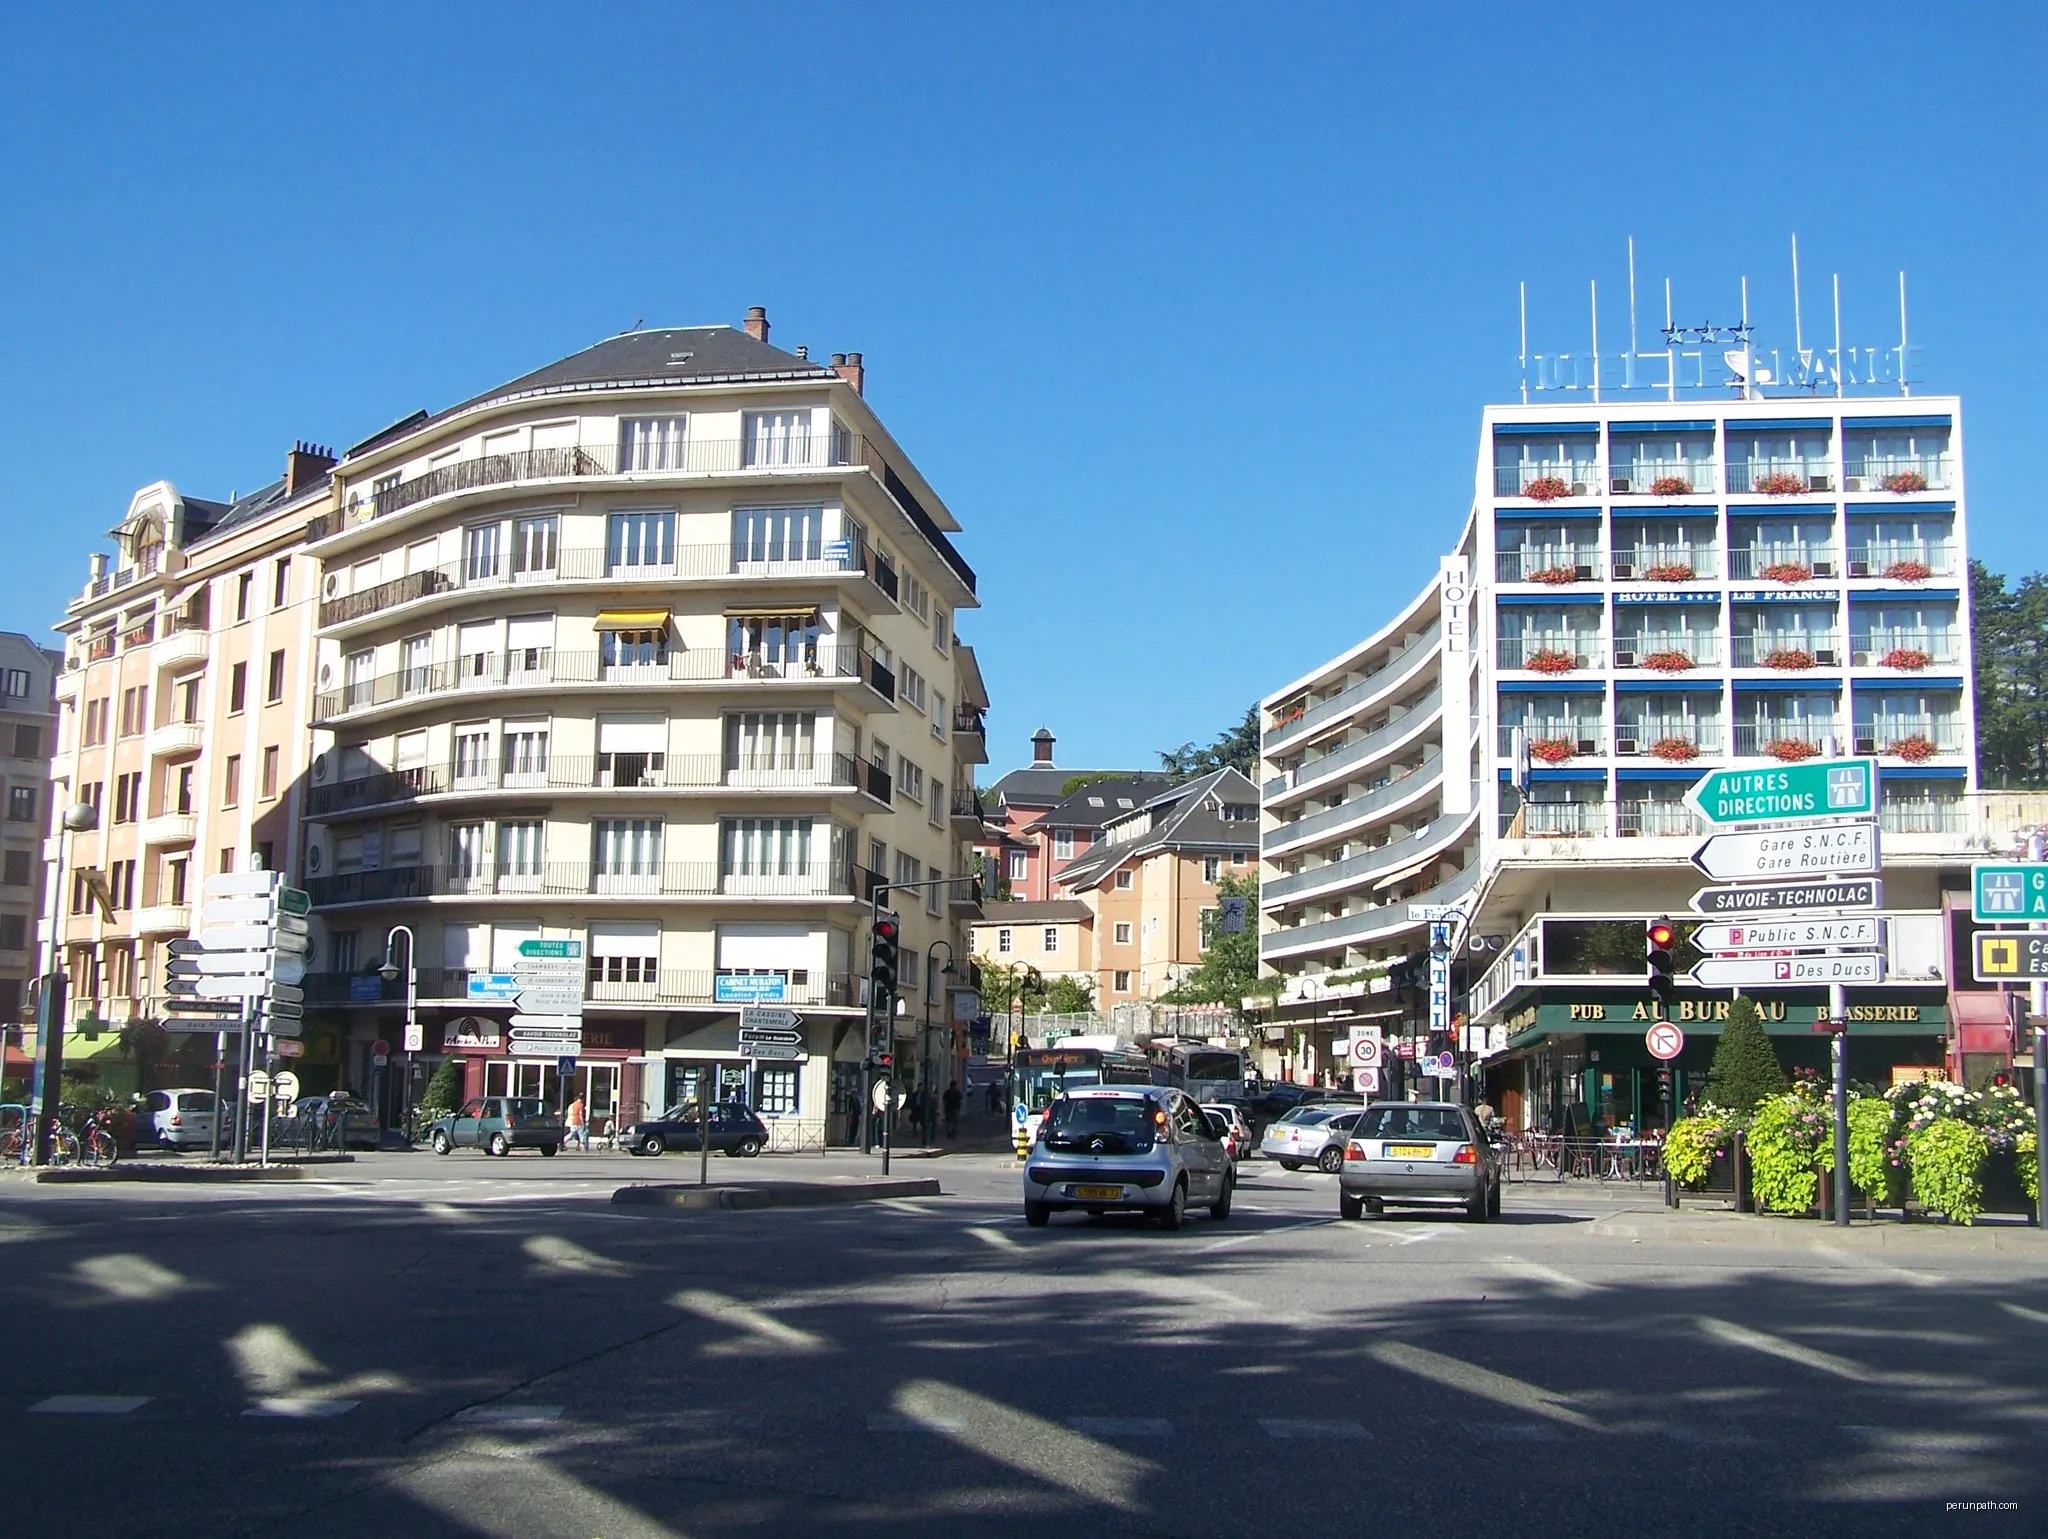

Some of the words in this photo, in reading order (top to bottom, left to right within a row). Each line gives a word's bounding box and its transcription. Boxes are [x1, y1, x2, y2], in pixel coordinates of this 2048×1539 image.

[1446, 571, 1464, 652] HOTEL
[1718, 773, 1789, 795] AUTRES
[1717, 793, 1815, 816] DIRECTIONS
[1760, 836, 1795, 851] Gare
[1804, 832, 1866, 849] S.N.C.F.
[1757, 854, 1791, 869] Gare
[1800, 851, 1866, 867] Routière
[1716, 886, 1868, 909] SAVOIE-TECHNOLAC
[1748, 927, 1797, 943] Public
[1806, 925, 1870, 941] S.N.C.F.
[1796, 963, 1823, 977] Des
[1832, 962, 1871, 976] Ducs
[757, 1010, 786, 1018] CASSINE
[1570, 1005, 1605, 1021] PUB
[1680, 1000, 1785, 1020] BURAU
[1816, 1005, 1918, 1021] BASSERIE
[744, 1032, 765, 1040] Forum
[1360, 1046, 1372, 1055] 30
